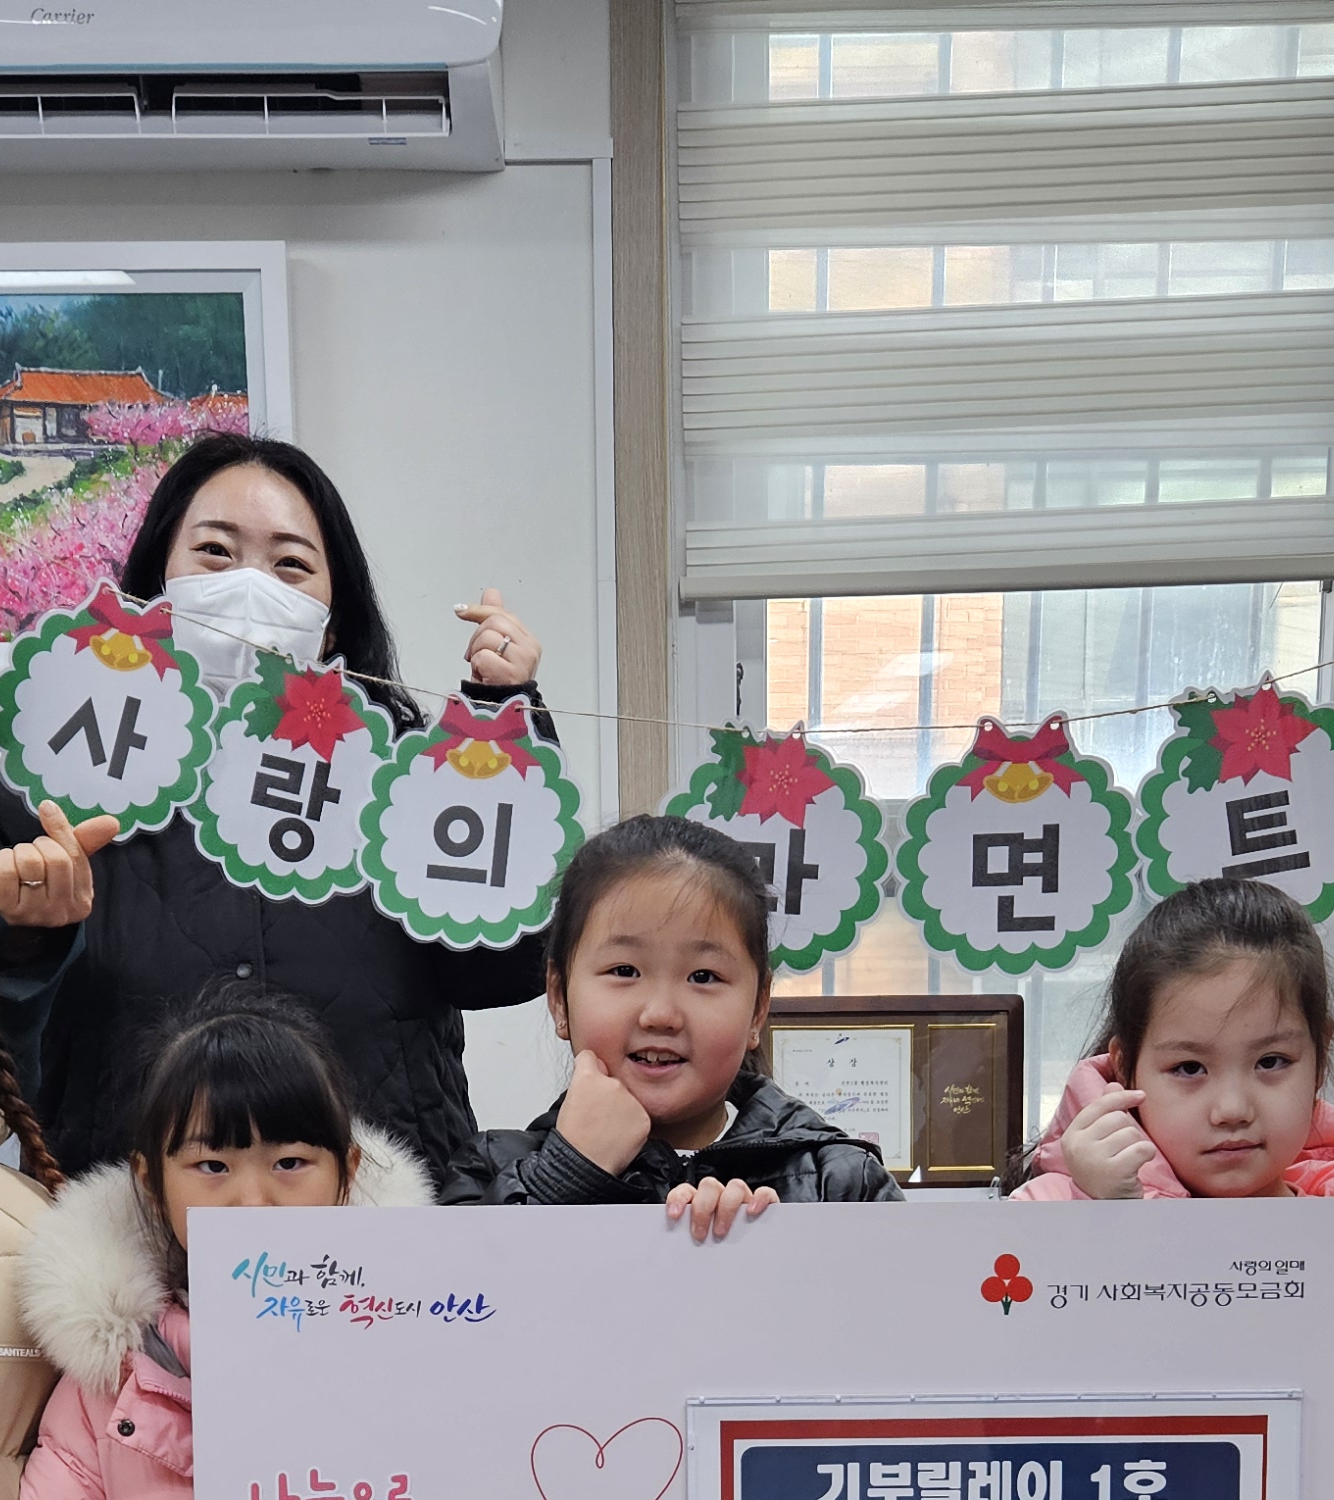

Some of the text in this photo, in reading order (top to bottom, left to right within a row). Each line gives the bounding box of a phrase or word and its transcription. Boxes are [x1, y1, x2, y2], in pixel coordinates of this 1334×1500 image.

[31, 8, 94, 24] Carrier
[231, 1251, 310, 1298] 시민과
[1047, 1280, 1306, 1310] 경기 사회복지공동모금회
[256, 1293, 498, 1333] 자유로운 혁신도시 안산
